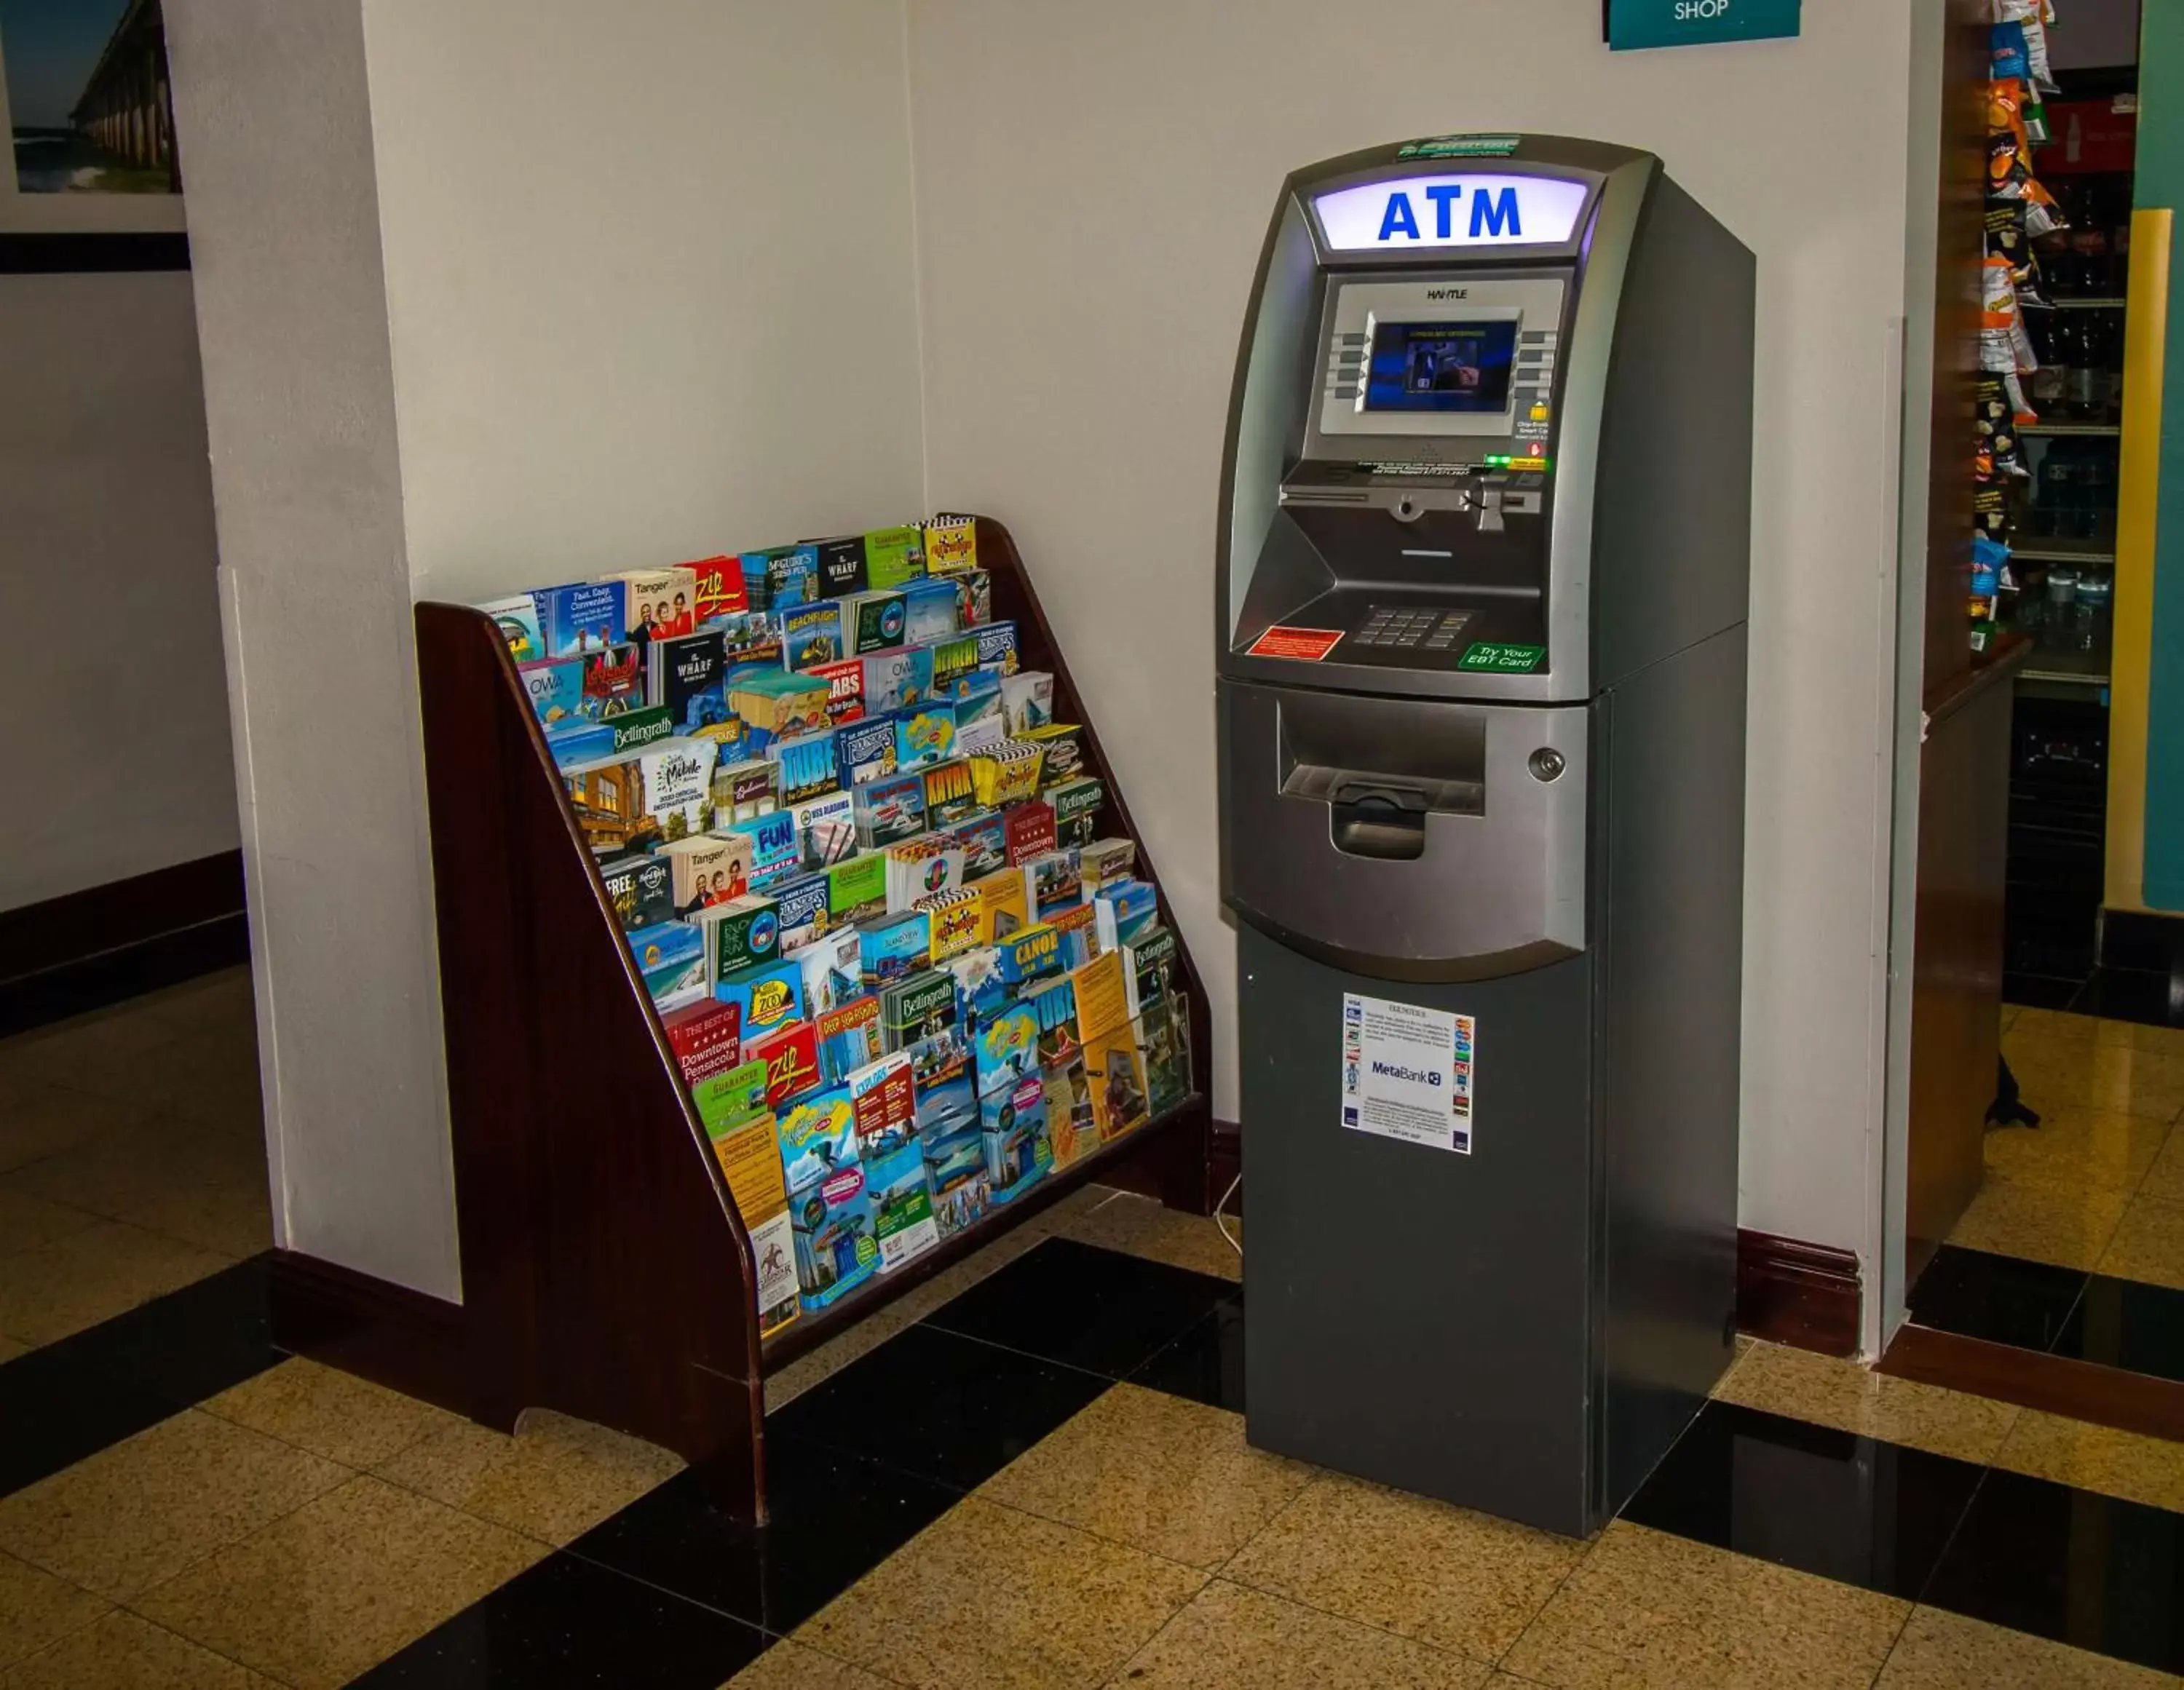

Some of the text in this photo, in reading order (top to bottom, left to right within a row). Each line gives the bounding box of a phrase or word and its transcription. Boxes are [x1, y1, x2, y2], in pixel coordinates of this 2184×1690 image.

[1674, 0, 1729, 20] SHOP
[1378, 185, 1522, 241] ATM
[828, 561, 858, 576] WHARF
[635, 582, 668, 595] Tanger
[1467, 655, 1531, 667] EBT Card
[1480, 646, 1533, 658] Try Your
[677, 658, 713, 677] WHARF
[530, 674, 565, 695] OWA
[614, 716, 673, 748] Bellingrath
[758, 820, 793, 853] FUN
[692, 850, 724, 866] Tanger
[606, 874, 632, 896] FREE
[759, 994, 783, 1012] ZOO
[903, 983, 953, 1016] Bellingrath
[686, 1023, 703, 1038] THE
[704, 1015, 723, 1033] BEST
[723, 1009, 735, 1022] OF
[681, 1036, 739, 1070] Downtown
[684, 1050, 735, 1081] Pensacola
[1372, 1060, 1428, 1083] MetaBank
